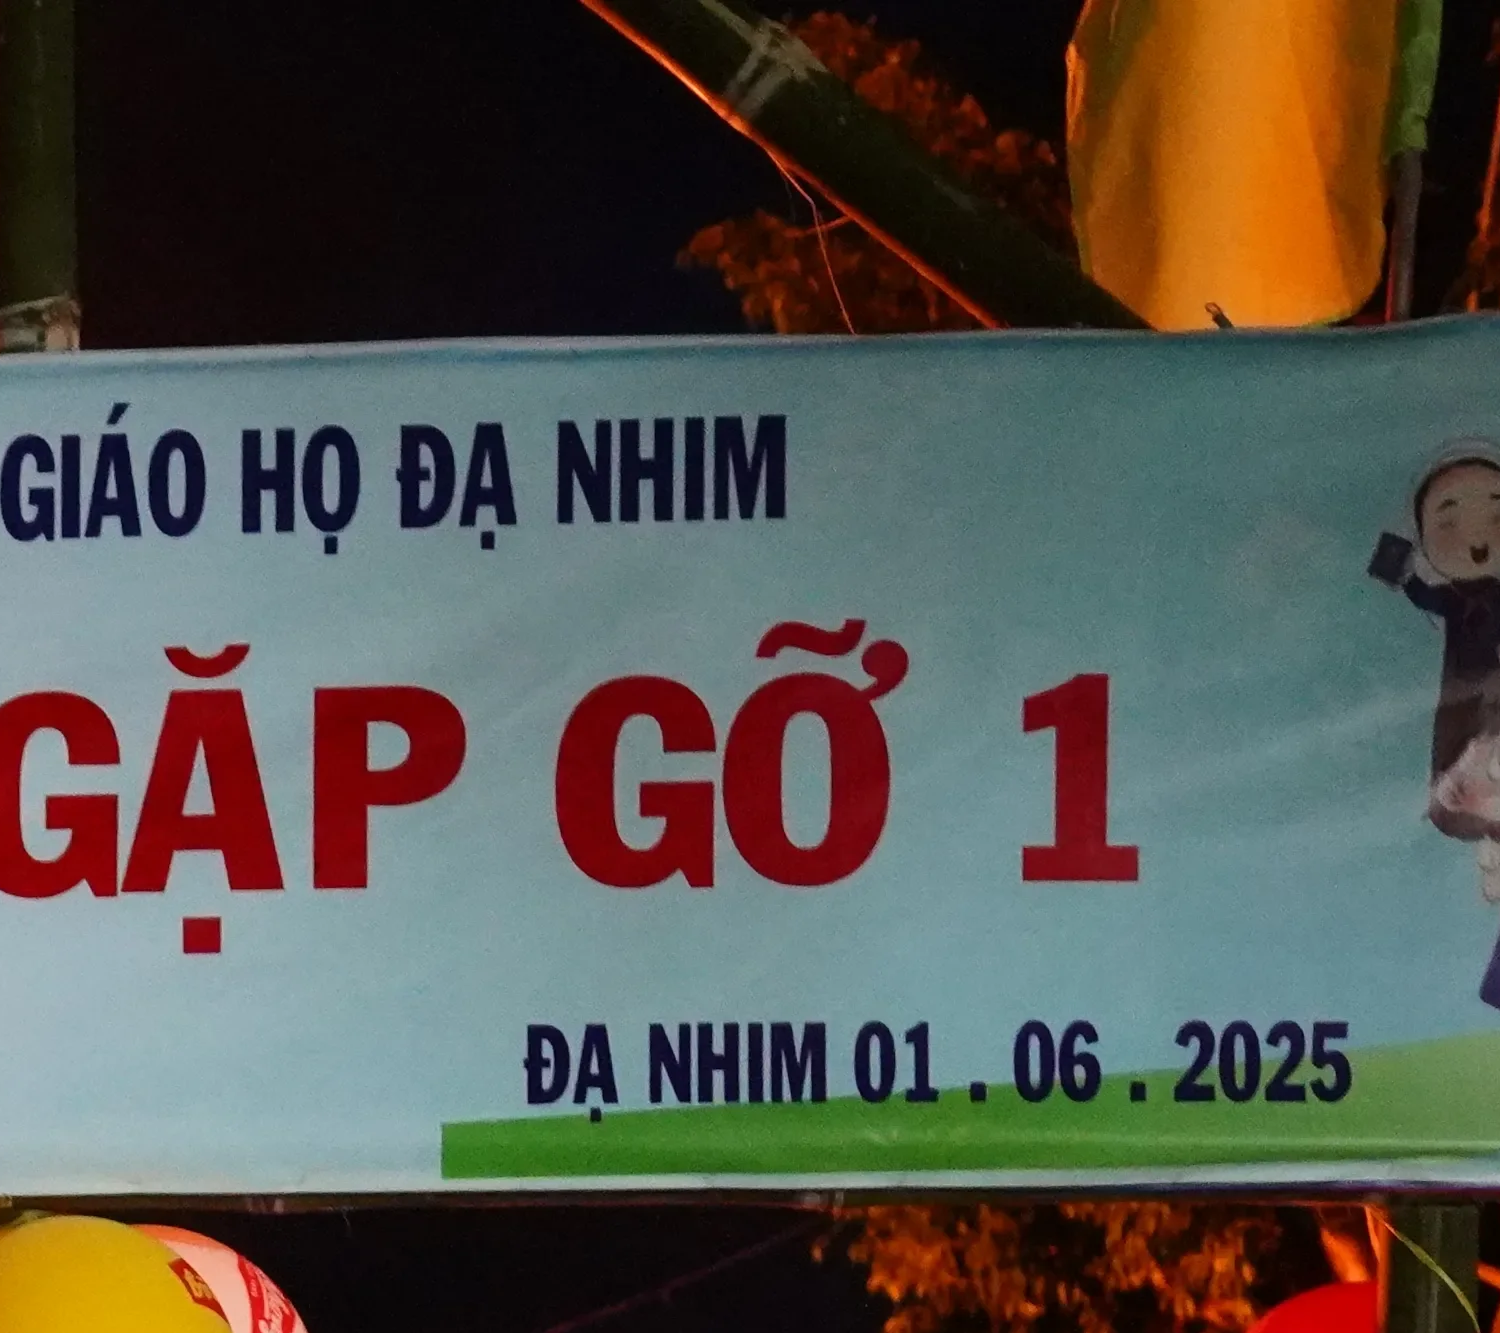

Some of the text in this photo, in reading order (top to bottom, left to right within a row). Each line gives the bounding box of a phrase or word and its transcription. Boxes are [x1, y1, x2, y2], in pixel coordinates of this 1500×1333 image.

[240, 423, 362, 556] HỌ
[394, 421, 518, 551] ĐẠ
[555, 412, 788, 526] NHIM
[554, 619, 909, 889] GỠ
[1022, 674, 1139, 882] 1
[522, 1023, 620, 1124] ĐẠ
[648, 1021, 828, 1105] NHIM
